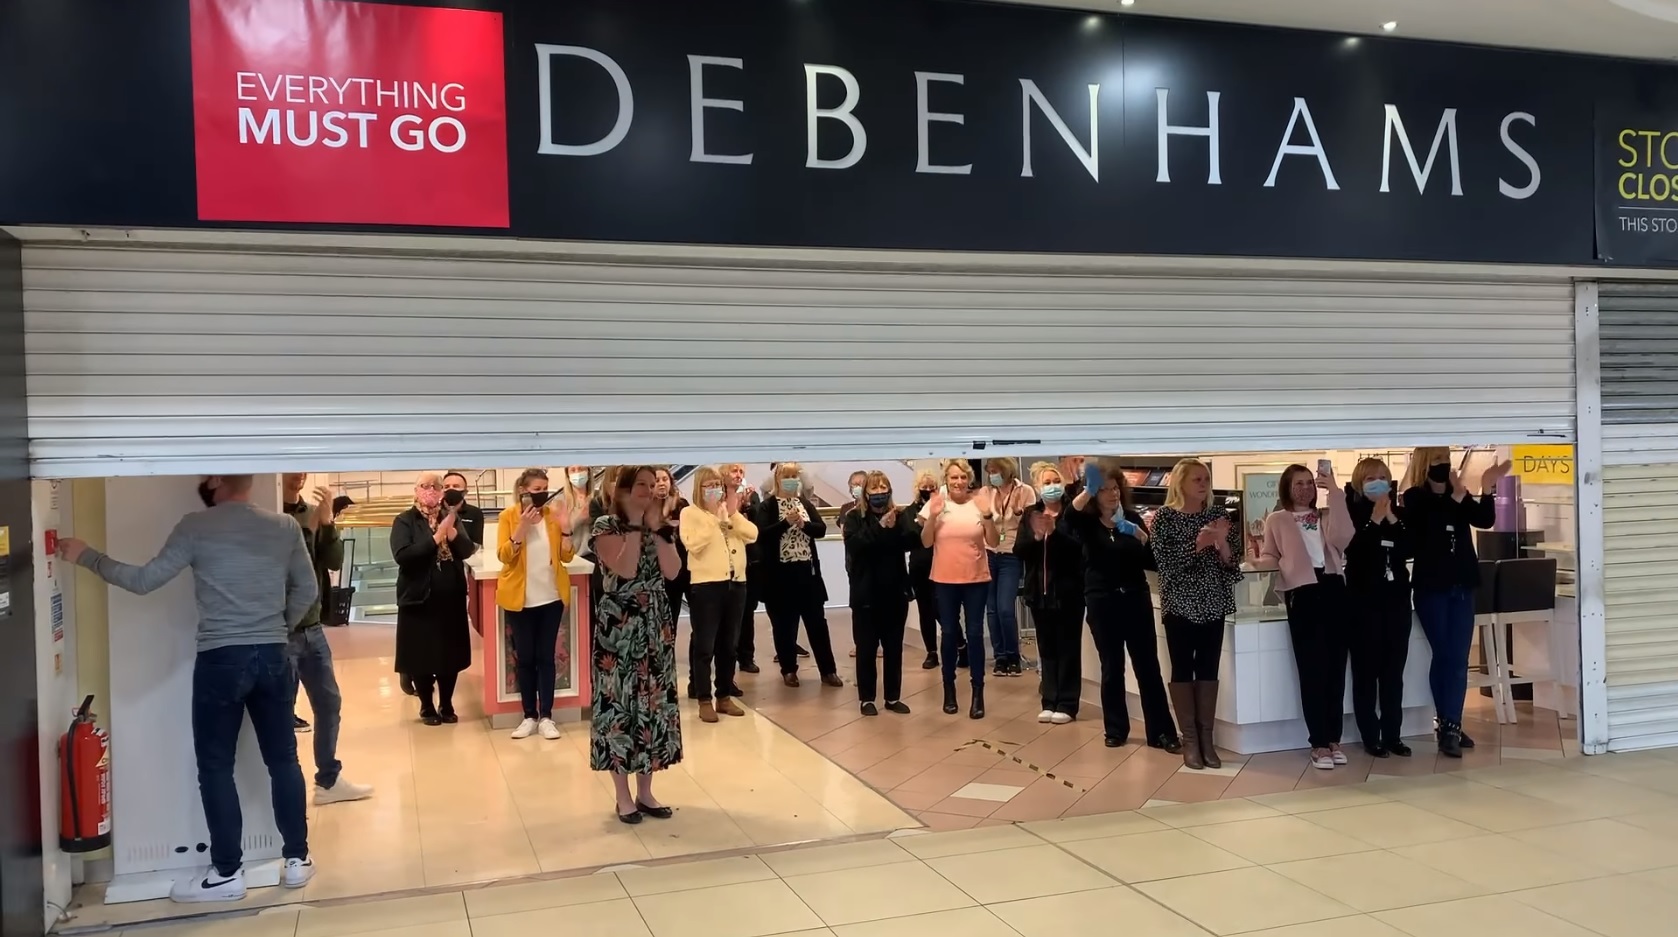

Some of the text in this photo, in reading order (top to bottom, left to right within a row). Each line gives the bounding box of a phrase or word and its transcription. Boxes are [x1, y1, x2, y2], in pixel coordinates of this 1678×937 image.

[236, 71, 466, 111] EVERYTHING
[237, 107, 467, 153] MUST GO
[534, 43, 1542, 200] DEBENHAMS
[1618, 129, 1678, 170] STO
[1618, 216, 1678, 233] THIS STO
[1523, 455, 1570, 474] DAYS
